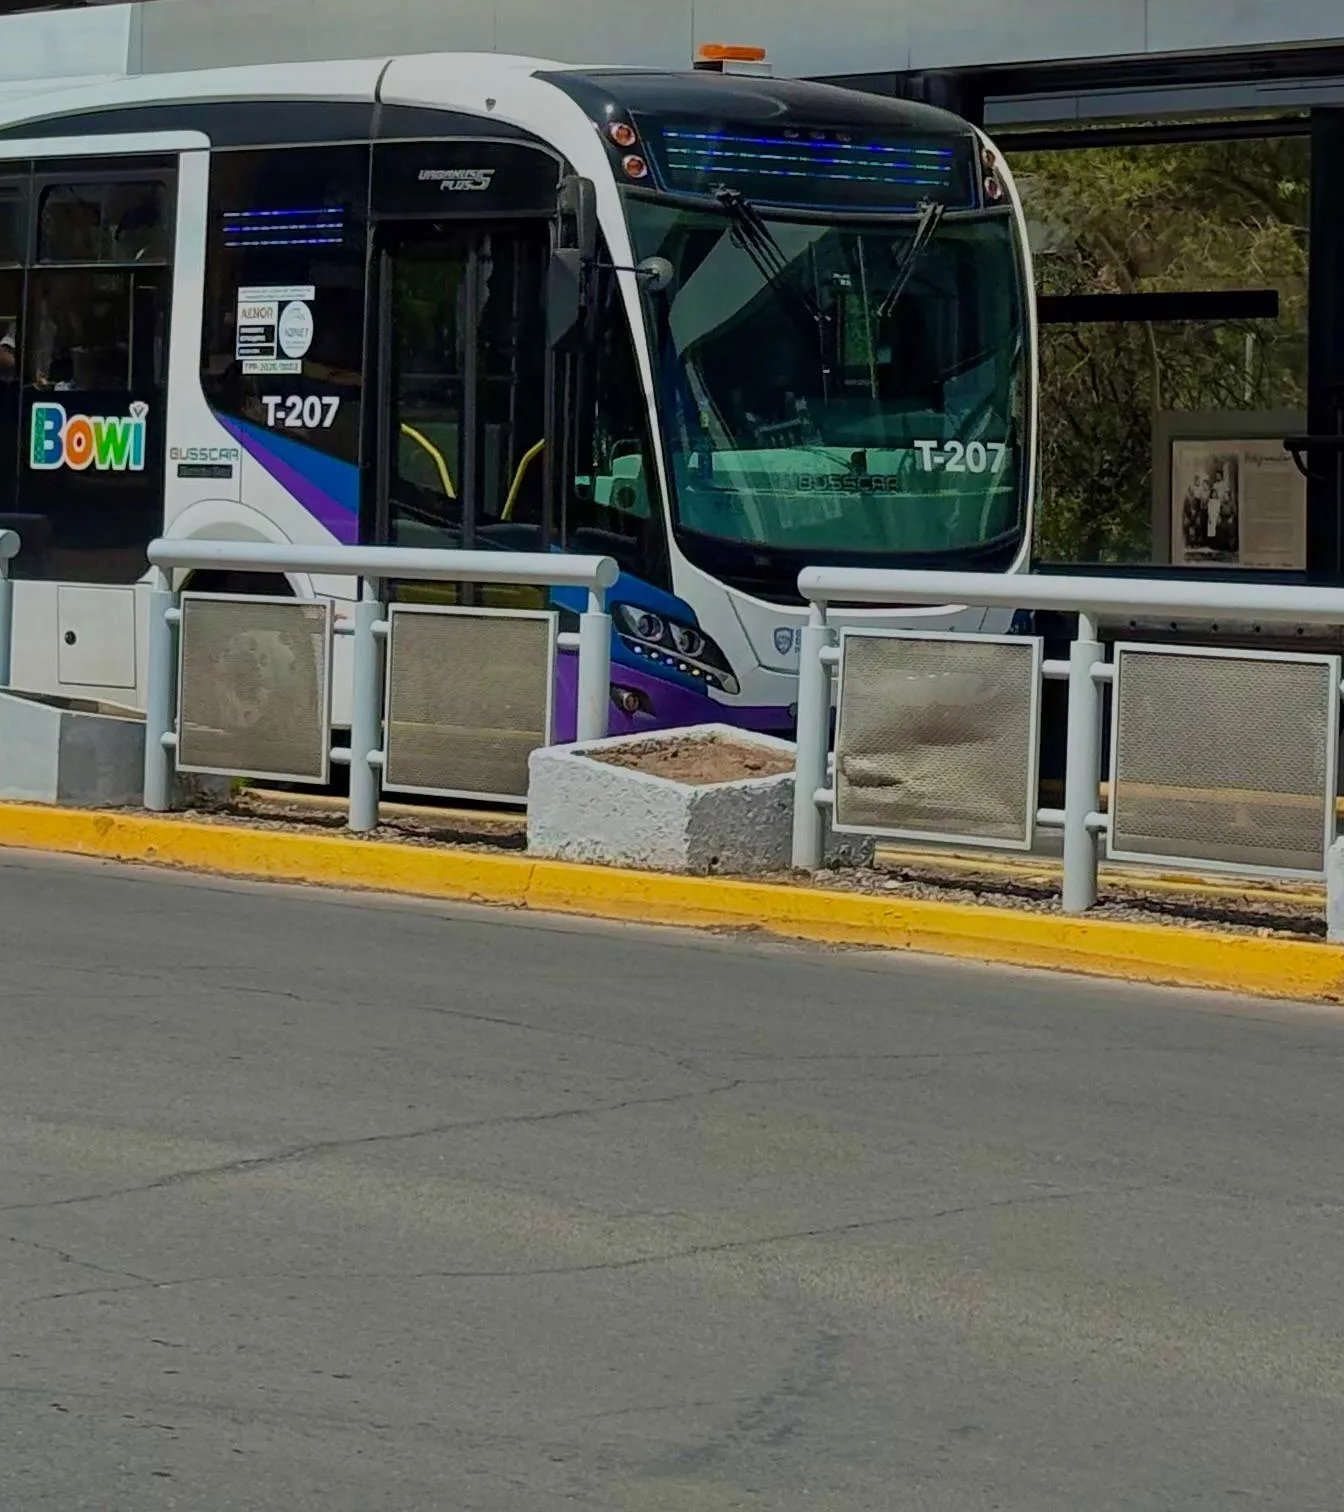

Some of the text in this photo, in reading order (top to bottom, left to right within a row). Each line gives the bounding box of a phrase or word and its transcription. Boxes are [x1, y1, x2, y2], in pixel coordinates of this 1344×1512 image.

[262, 394, 341, 429] T-207
[169, 447, 240, 462] BUSSCAR
[913, 439, 1007, 474] T-207
[797, 474, 899, 492] BUSSCAR
